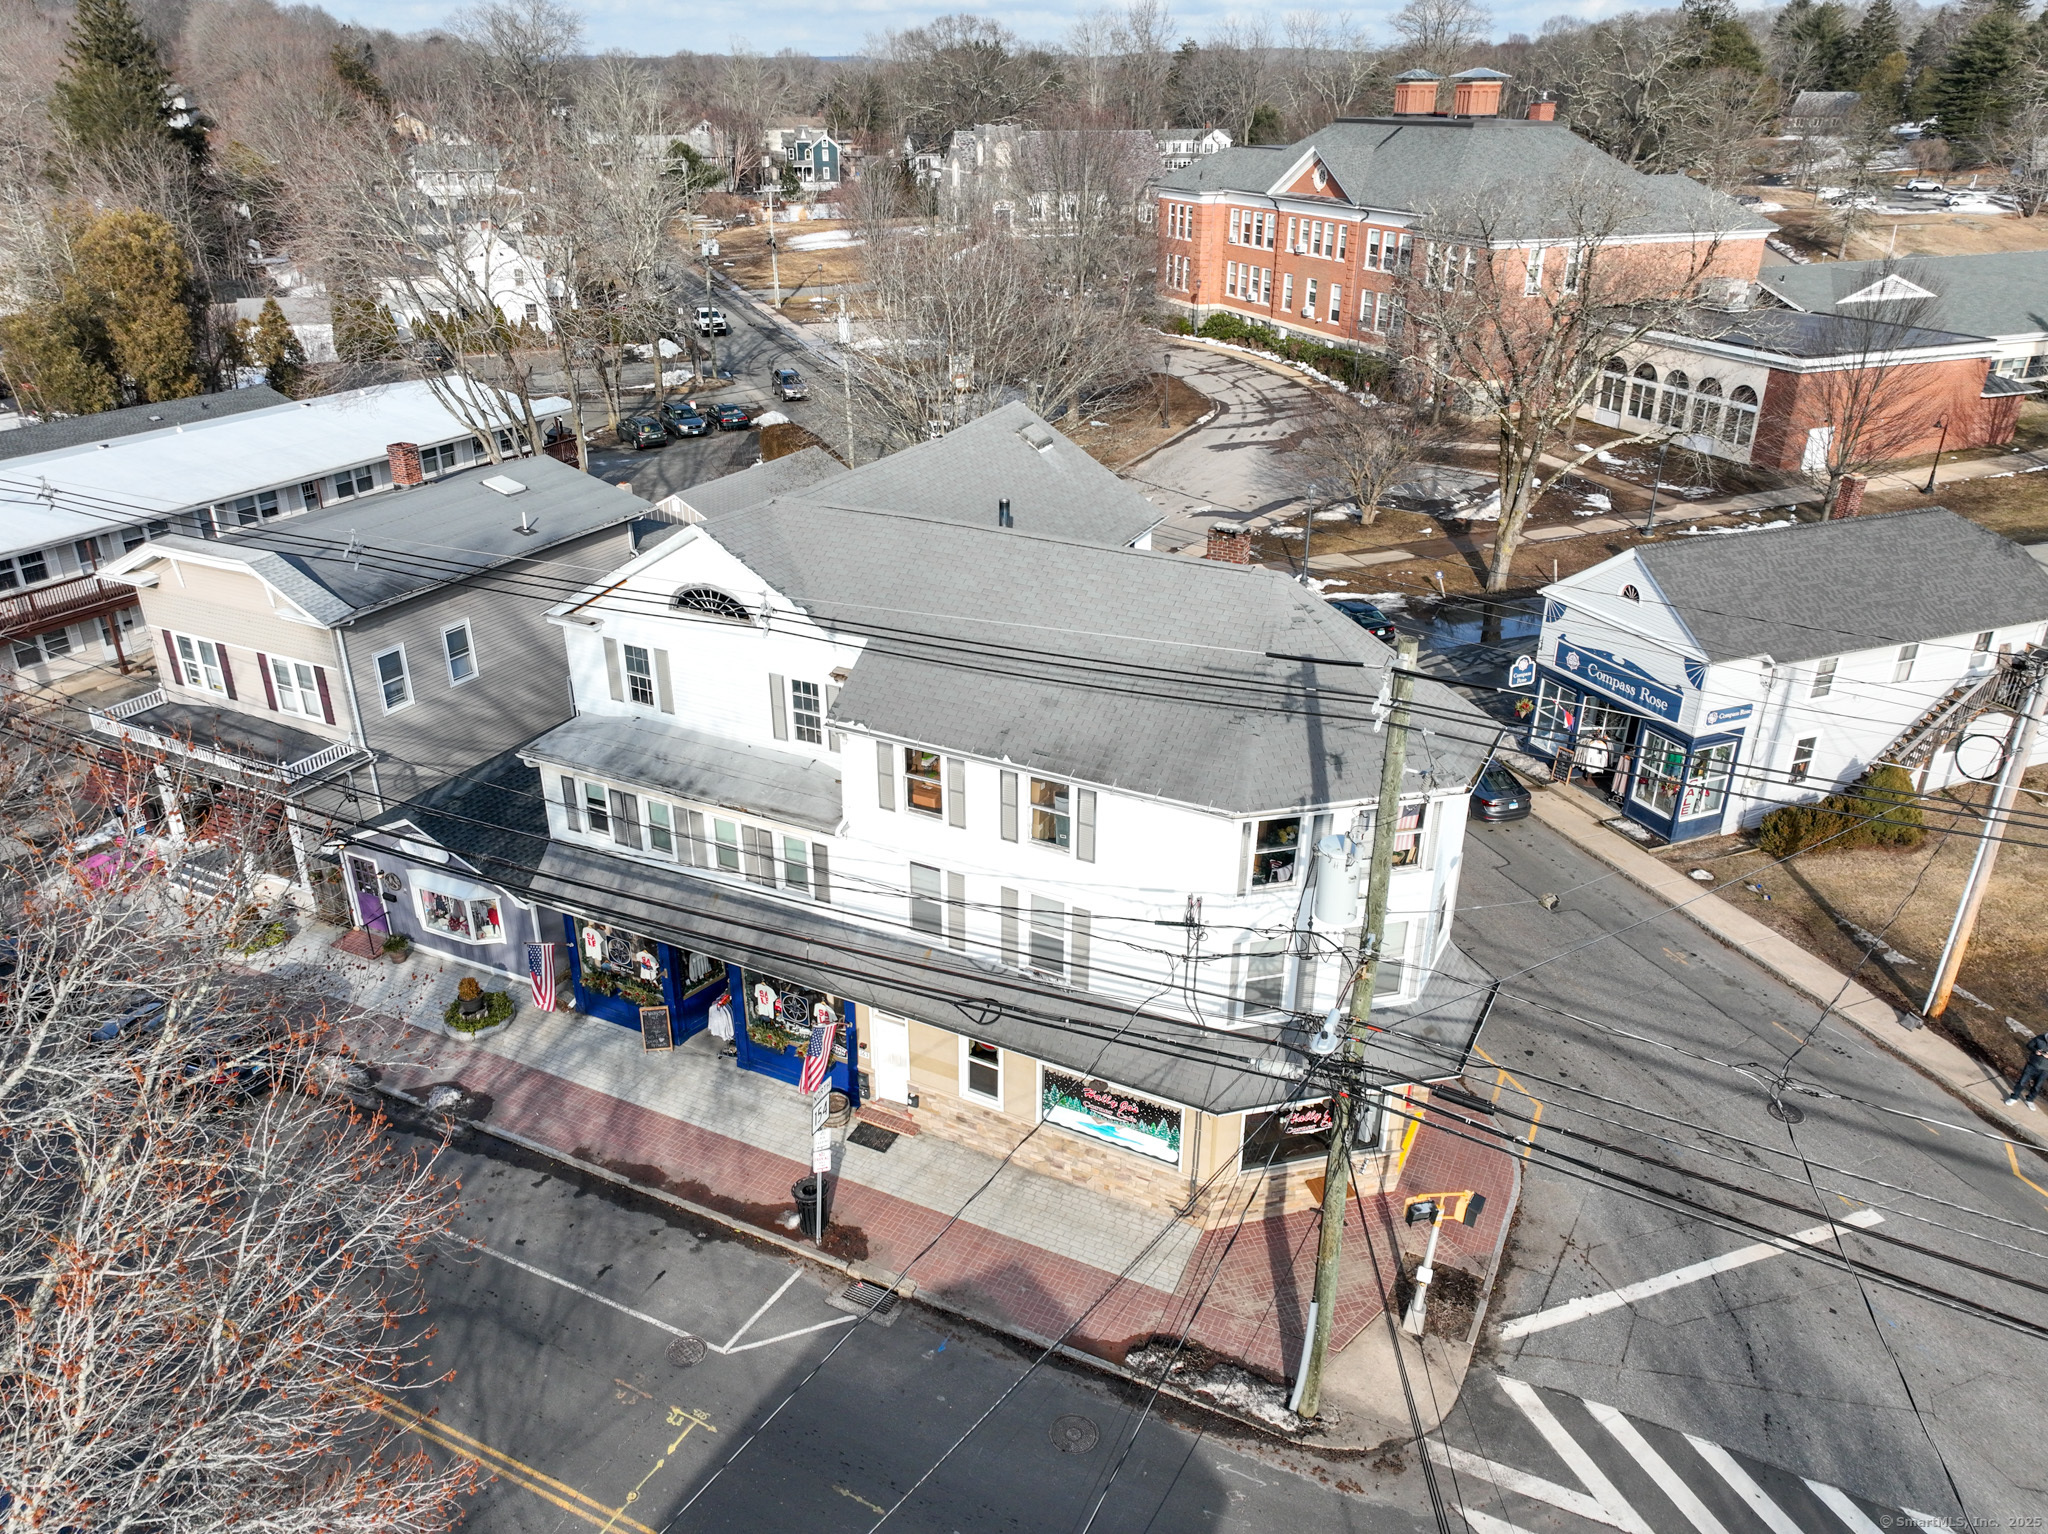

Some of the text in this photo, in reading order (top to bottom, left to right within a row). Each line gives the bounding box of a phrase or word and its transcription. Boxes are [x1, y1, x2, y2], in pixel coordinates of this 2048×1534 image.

[1587, 663, 1668, 711] Compass Rose
[1719, 711, 1740, 720] Compass
[813, 1080, 831, 1101] NORTH
[1083, 1087, 1118, 1109] Holly
[814, 1101, 828, 1127] 154
[1285, 1110, 1322, 1125] Holly
